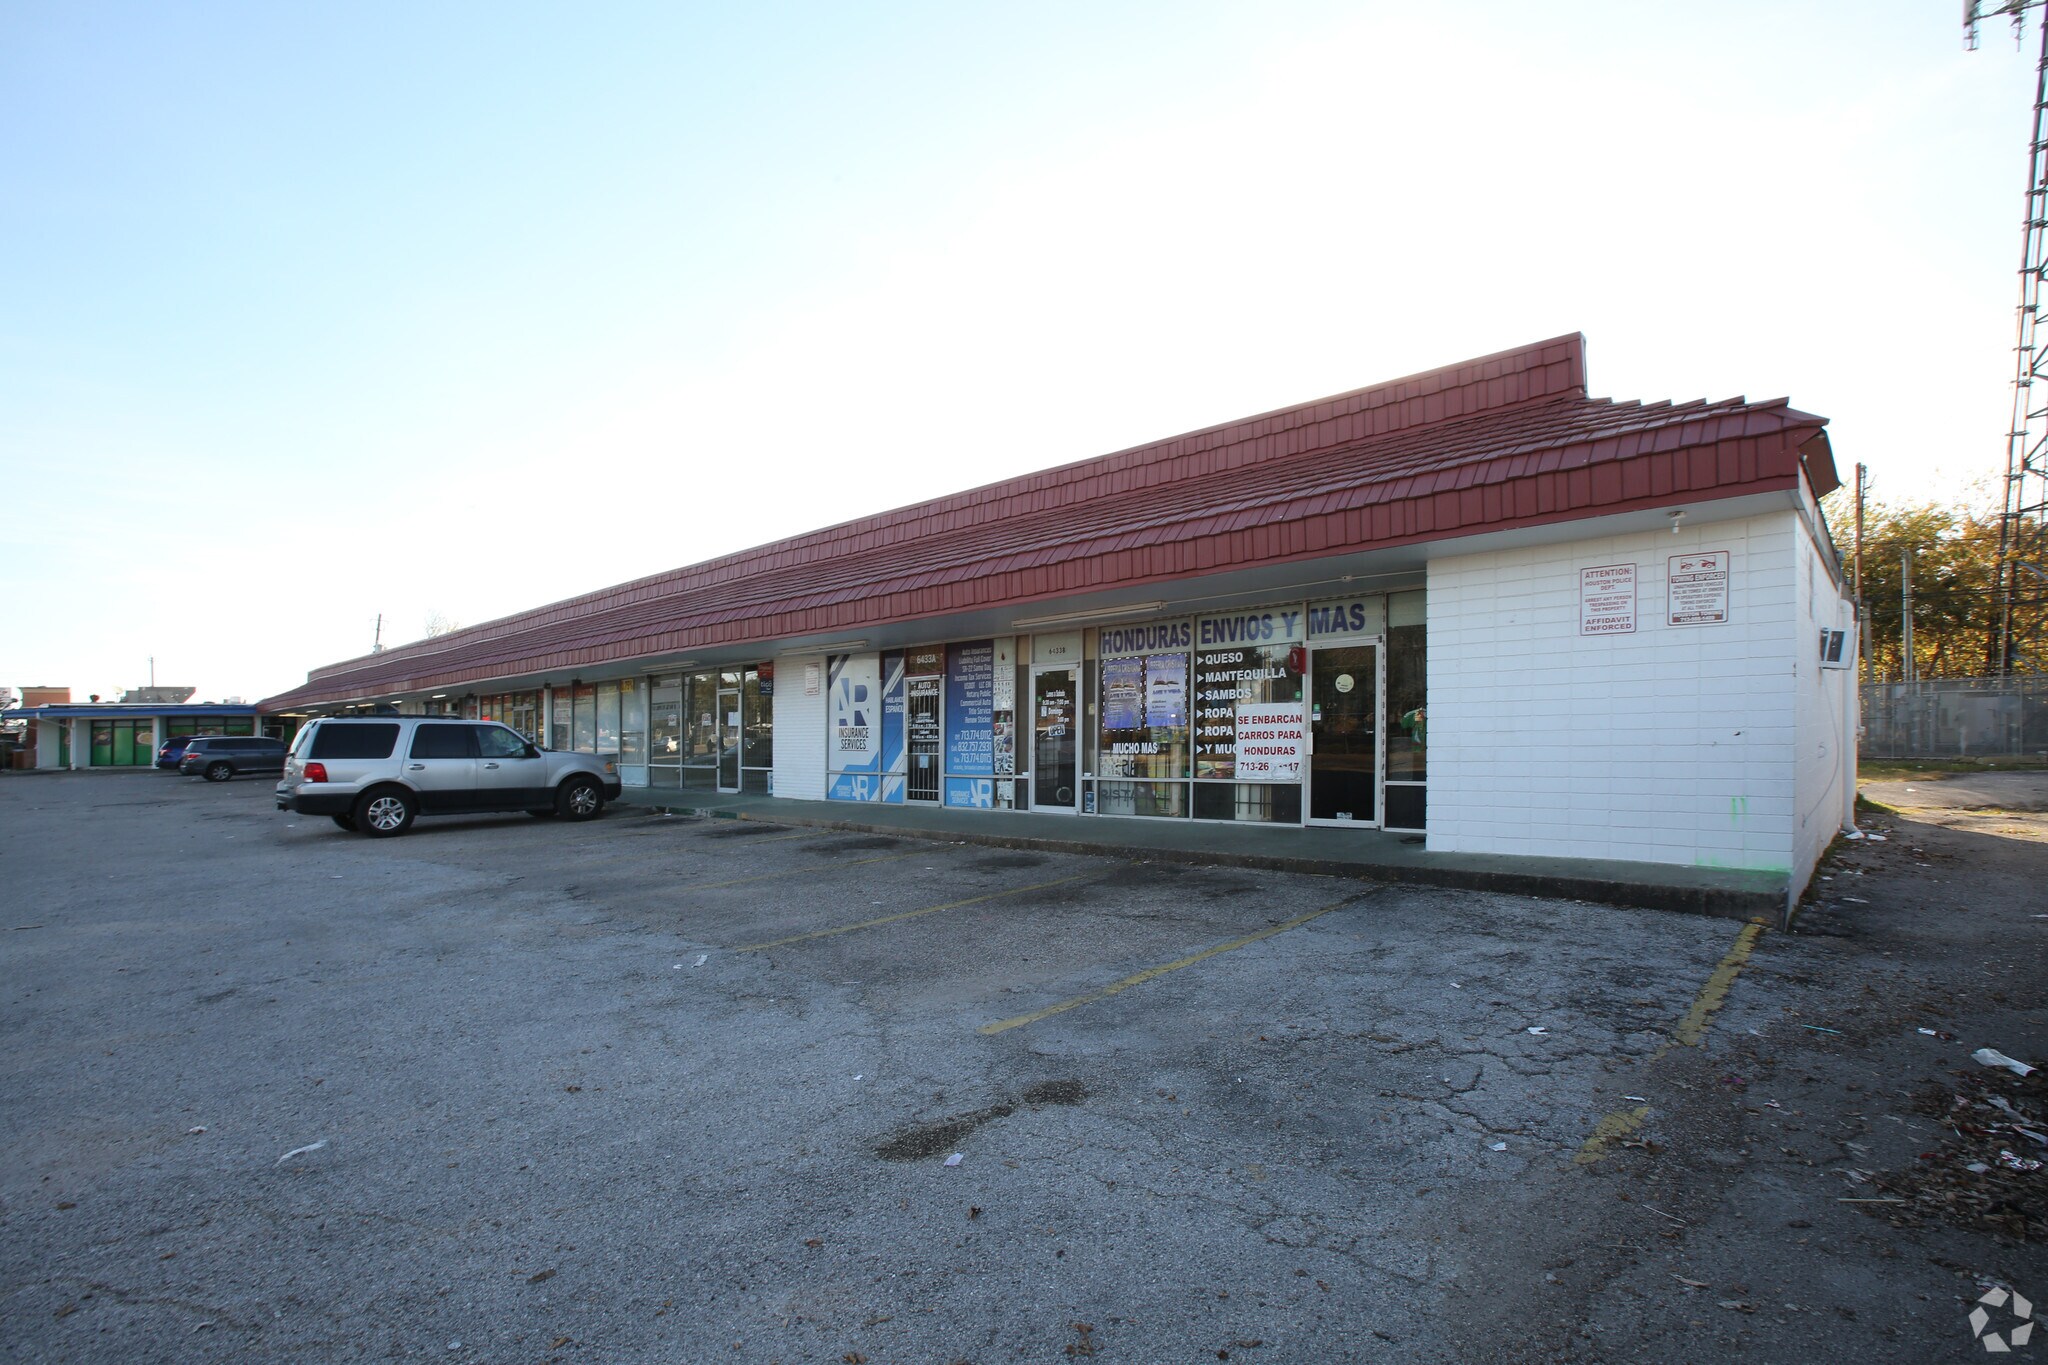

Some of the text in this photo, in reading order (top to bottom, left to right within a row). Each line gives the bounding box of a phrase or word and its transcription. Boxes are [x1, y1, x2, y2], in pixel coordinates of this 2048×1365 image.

[1585, 568, 1632, 578] ATTENTION:
[1672, 571, 1725, 583] TOWING ENFORCED
[1586, 616, 1631, 625] AFFIDAVIT
[1102, 603, 1364, 655] HONDURAS ENVIOS Y MAS
[1585, 623, 1632, 631] ENFORCED
[1205, 652, 1243, 665] QUESO
[1205, 668, 1287, 683] MANTEQUILLA
[1205, 688, 1252, 701] SAMBOS
[1204, 708, 1234, 718] ROPA
[1237, 715, 1302, 725] SE ENBARCAN
[838, 727, 869, 739] INSURANCE
[1204, 726, 1234, 736] ROPA
[1238, 730, 1303, 741] CARROS PARA
[840, 739, 868, 750] SERVICES
[1112, 742, 1159, 755] MUCHO MAS
[1204, 744, 1213, 754] Y
[1243, 747, 1295, 756] HONDURAS
